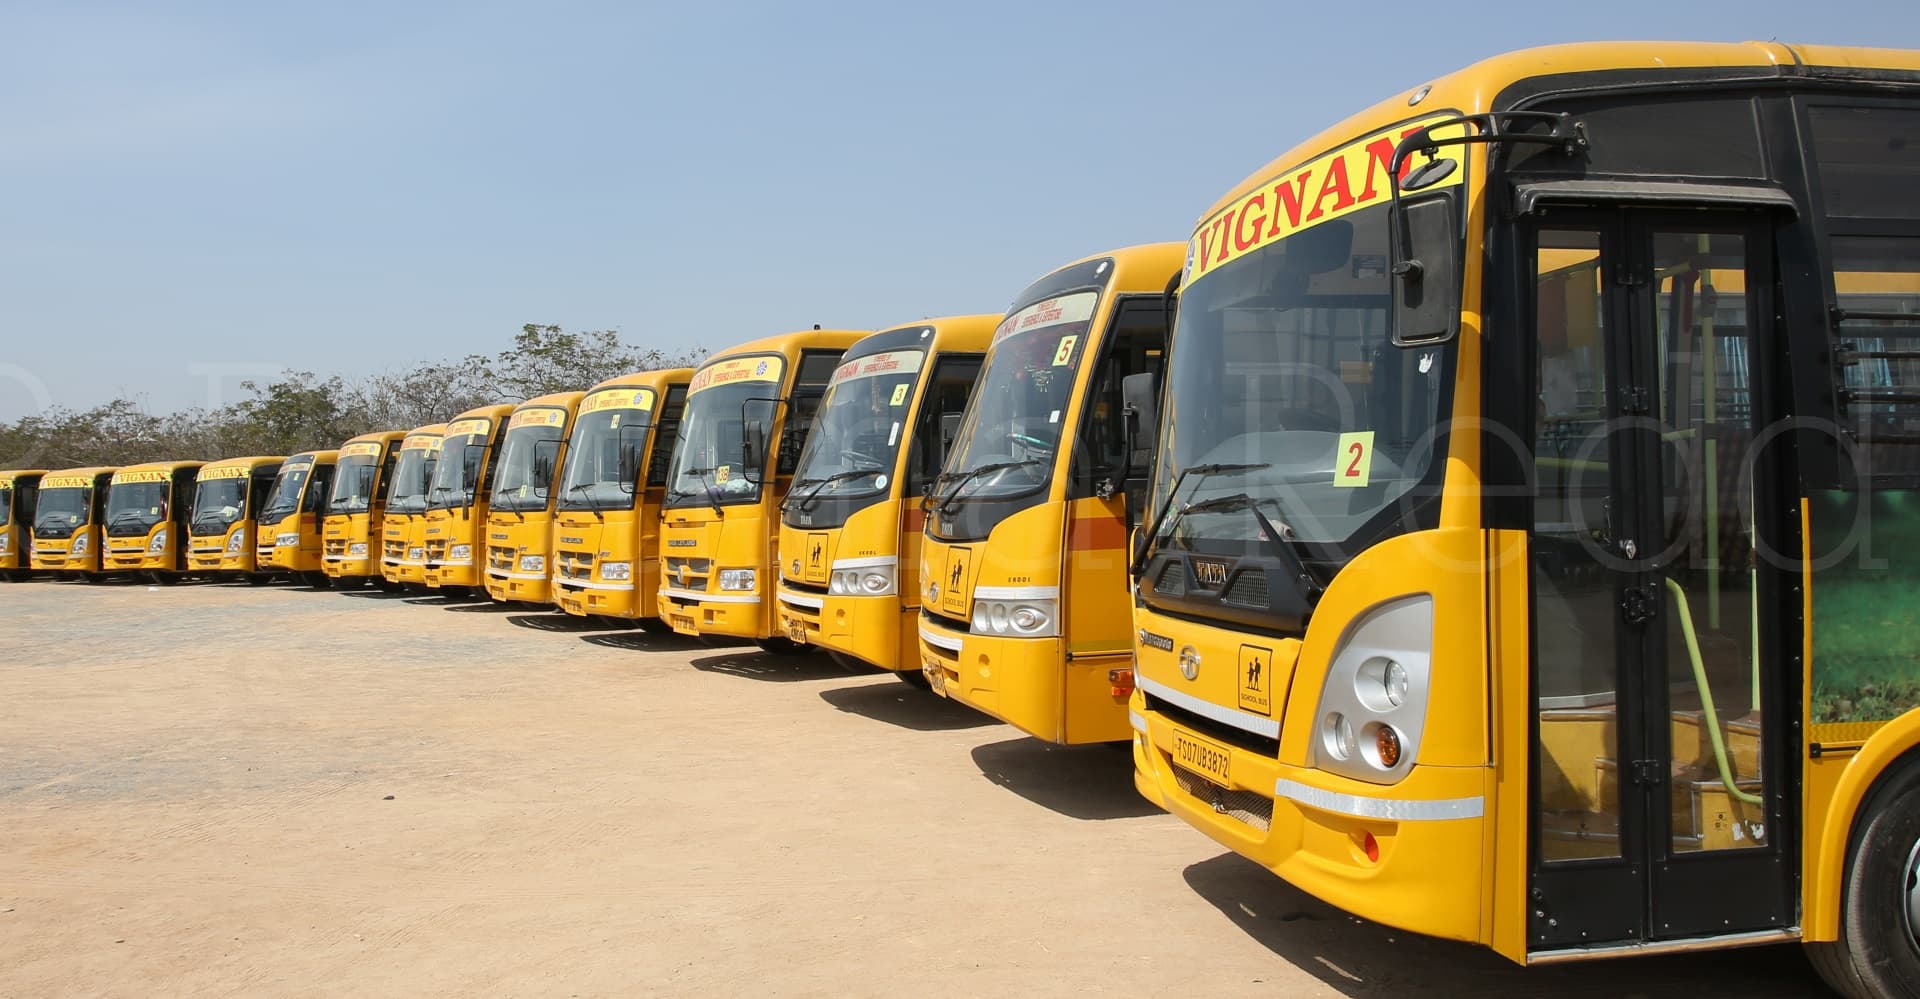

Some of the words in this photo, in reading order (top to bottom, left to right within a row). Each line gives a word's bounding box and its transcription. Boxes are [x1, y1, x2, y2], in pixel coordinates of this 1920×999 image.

[1198, 126, 1426, 272] VIGNAN
[1059, 340, 1072, 362] 5
[895, 388, 904, 402] 3
[1345, 442, 1364, 477] 2
[118, 472, 165, 482] VIGNAN
[201, 468, 244, 478] VIGNAN
[46, 478, 88, 487] VIGNAN
[1196, 560, 1228, 584] TATA
[1240, 692, 1258, 705] SCHOOL
[1258, 697, 1267, 706] BUS
[1178, 737, 1229, 778] TS07UB3872
